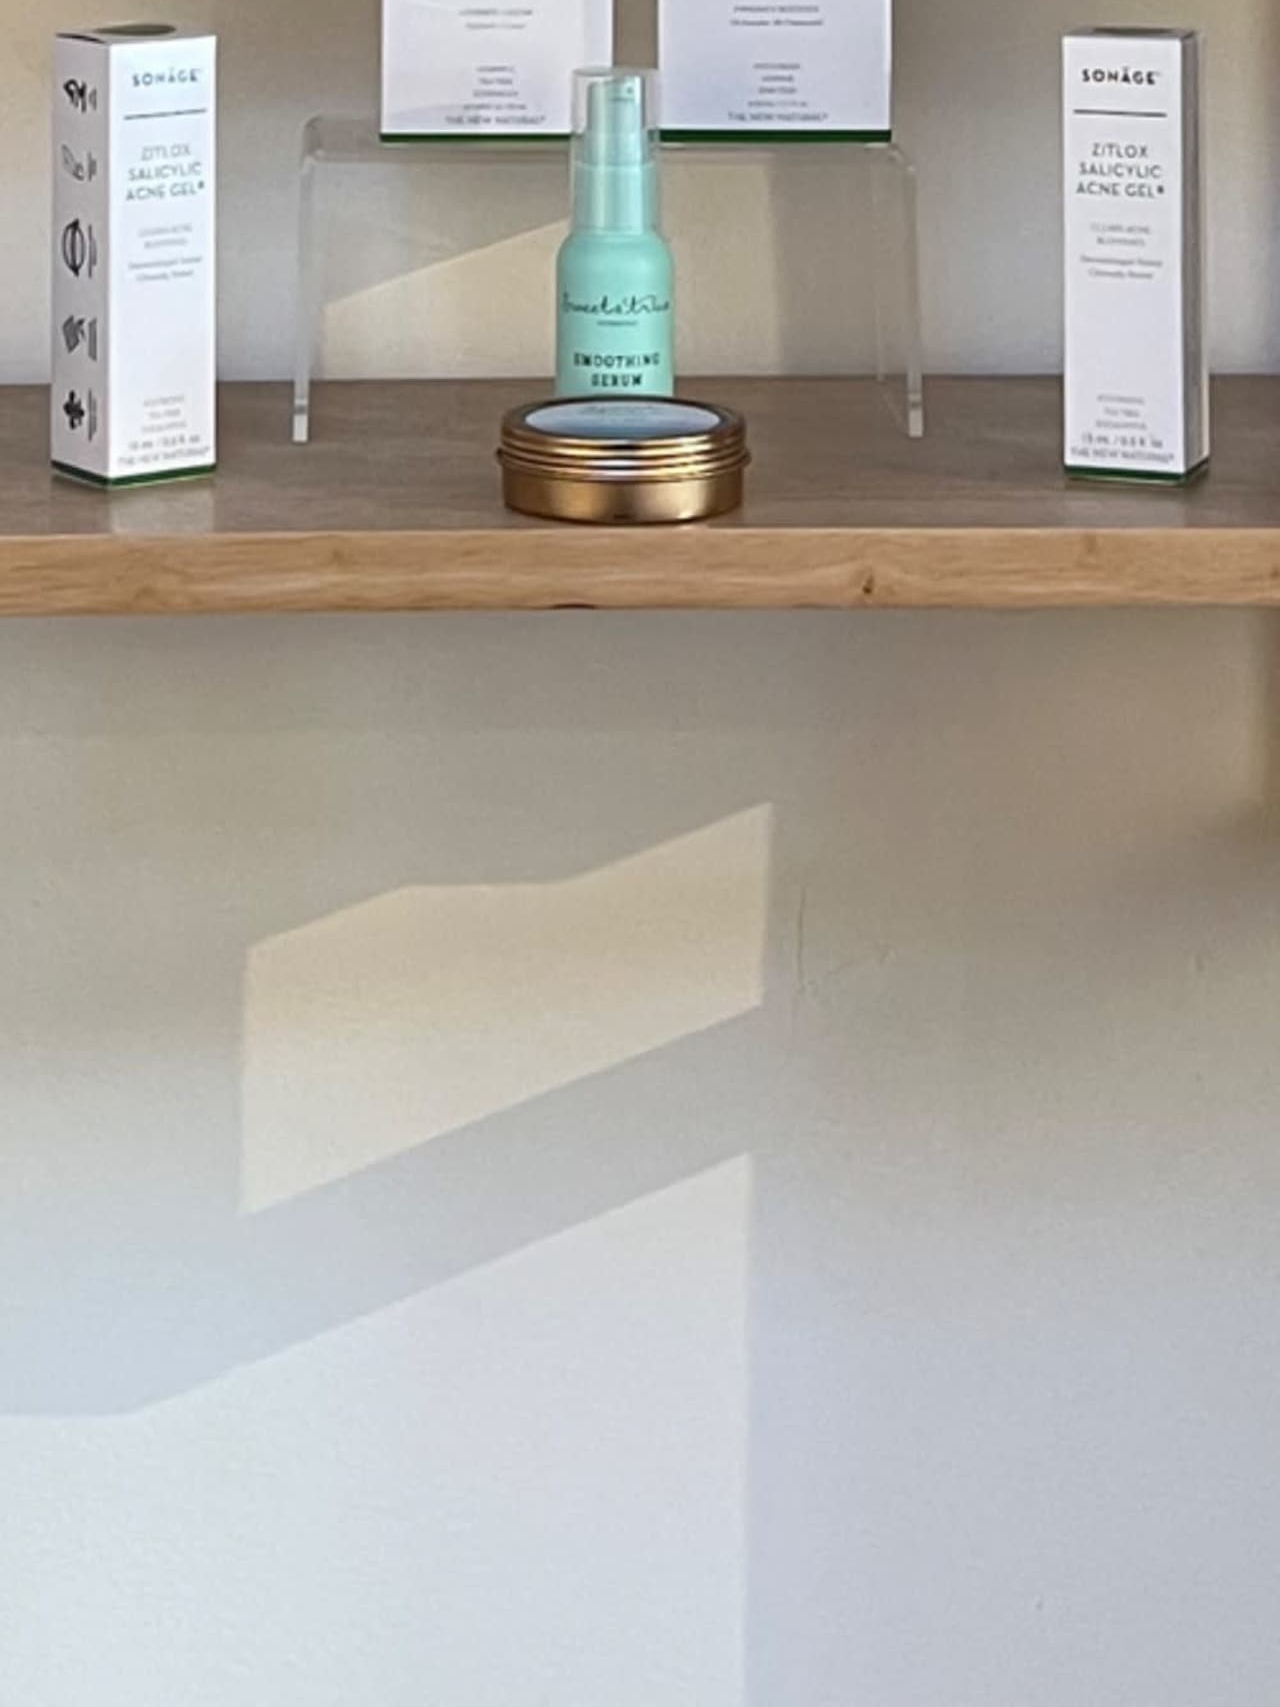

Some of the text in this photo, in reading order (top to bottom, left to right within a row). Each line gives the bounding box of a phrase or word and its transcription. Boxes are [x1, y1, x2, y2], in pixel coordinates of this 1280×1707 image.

[1091, 143, 1149, 159] ZITLOX
[128, 161, 202, 181] SALICYLIC
[1079, 161, 1162, 179] SALICYLIC
[126, 185, 165, 201] ACNE
[1075, 182, 1120, 196] ACNE
[573, 352, 660, 369] SMOOTHING
[592, 374, 643, 389] SERUM
